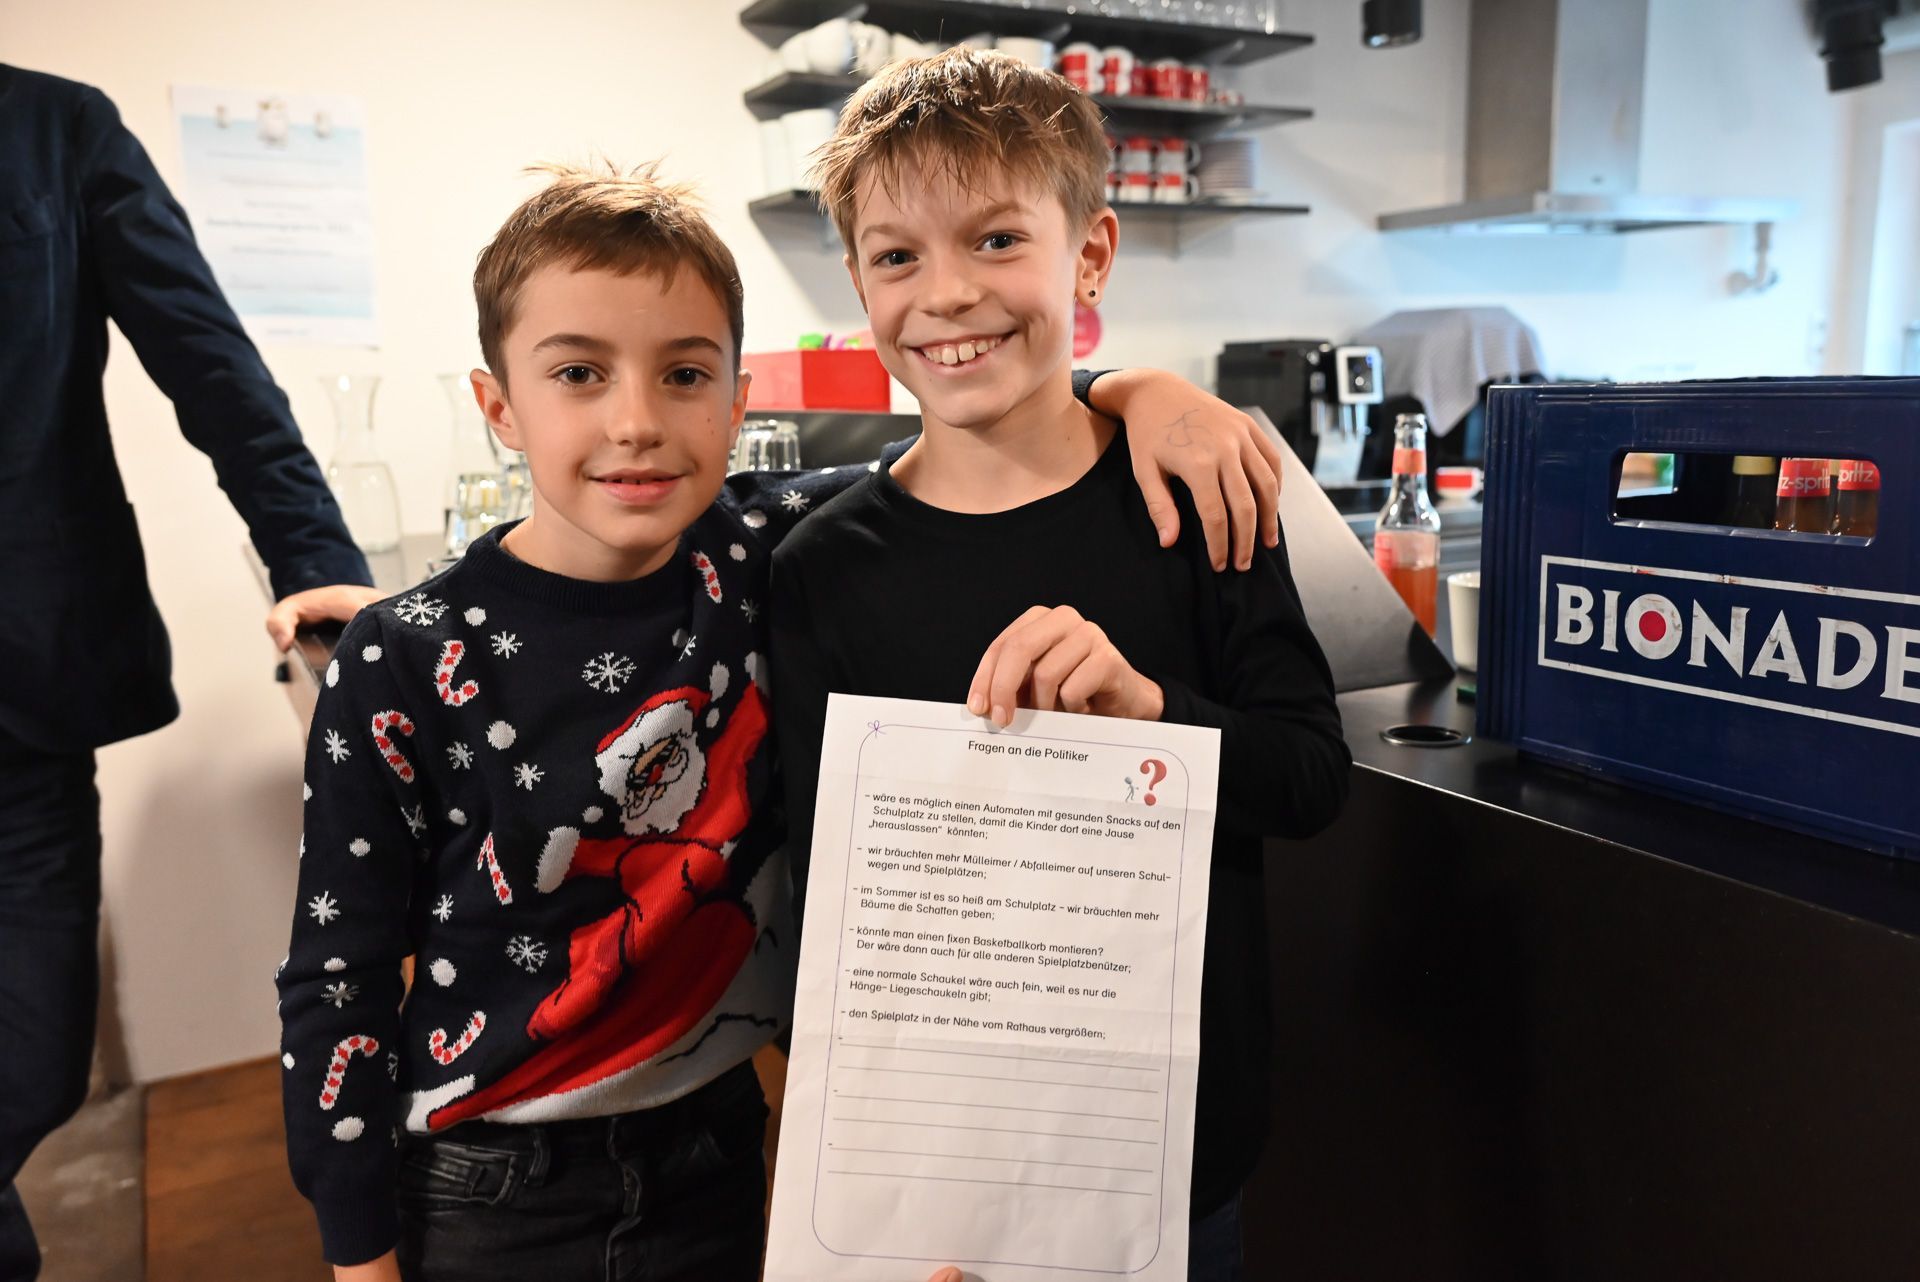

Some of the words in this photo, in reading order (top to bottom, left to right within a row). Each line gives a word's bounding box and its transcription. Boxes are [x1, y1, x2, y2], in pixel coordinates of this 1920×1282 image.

[1553, 582, 1920, 704] BIONADE
[968, 740, 1005, 755] Fragen
[1007, 746, 1022, 755] an
[1024, 746, 1042, 758] die
[1044, 748, 1089, 762] Politiker
[872, 793, 896, 803] wäre
[899, 796, 911, 805] es
[913, 797, 952, 809] möglich
[954, 801, 981, 811] einen
[983, 803, 1035, 817] Automaten
[1037, 809, 1053, 818] mit
[1055, 812, 1103, 823] gesunden
[1106, 814, 1142, 827] Snacks
[1144, 819, 1160, 830] auf
[1162, 820, 1181, 830] den
[873, 805, 925, 819] Schulplatz
[927, 813, 939, 821] zu
[942, 813, 976, 826] stellen,
[979, 816, 1006, 827] damit
[1008, 819, 1023, 829] die
[1026, 820, 1058, 832] Kinder
[1059, 824, 1079, 834] dort
[1081, 826, 1103, 836] eine
[1105, 828, 1135, 839] Jause
[947, 826, 988, 840] könnten;
[867, 861, 900, 872] wegen
[902, 863, 921, 872] und
[924, 864, 987, 880] Spielplätzen;
[868, 846, 882, 855] wir
[884, 847, 933, 860] bräuchten
[935, 853, 961, 862] mehr
[963, 854, 1012, 867] Mülleimer
[1019, 860, 1076, 873] Abfalleimer
[1077, 866, 1094, 877] auf
[1096, 868, 1136, 879] unseren
[860, 898, 896, 910] Bäume
[898, 902, 913, 912] die
[916, 903, 959, 916] Schatten
[961, 909, 995, 920] geben;
[861, 885, 873, 895] im
[876, 886, 917, 899] Sommer
[919, 890, 931, 900] ist
[933, 893, 945, 902] es
[948, 895, 960, 903] so
[962, 894, 984, 905] heiß
[986, 898, 1002, 907] am
[1005, 898, 1056, 912] Schulplatz
[1067, 905, 1081, 914] wir
[1083, 906, 1132, 919] bräuchten
[1134, 911, 1160, 921] mehr
[856, 939, 875, 950] Der
[877, 942, 900, 952] wäre
[903, 943, 928, 954] dann
[930, 947, 955, 957] auch
[957, 948, 971, 959] für
[973, 950, 991, 960] alle
[994, 953, 1035, 964] anderen
[1038, 955, 1131, 974] Spielplatzbenützer;
[857, 926, 890, 938] könnte
[893, 930, 914, 939] man
[917, 931, 944, 942] einen
[947, 933, 970, 945] fixen
[973, 936, 1047, 951] Basketballkorb
[1049, 945, 1104, 956] montieren?
[853, 967, 874, 978] eine
[877, 971, 917, 981] normale
[920, 972, 966, 985] Schaukel
[969, 977, 992, 988] wäre
[995, 980, 1019, 990] auch
[1022, 981, 1043, 993] fein,
[1046, 985, 1065, 994] weil
[1068, 987, 1080, 996] es
[1083, 988, 1099, 997] nur
[1101, 988, 1116, 999] die
[889, 983, 967, 999] Liegeschaukeln
[969, 991, 991, 1003] gibt;
[848, 1008, 868, 1019] den
[871, 1010, 919, 1023] Spielplatz
[922, 1014, 931, 1023] in
[933, 1015, 950, 1025] der
[953, 1017, 979, 1028] Nähe
[982, 1021, 1003, 1030] vom
[1006, 1021, 1047, 1034] Rathaus
[1049, 1027, 1106, 1040] vergrößern;
